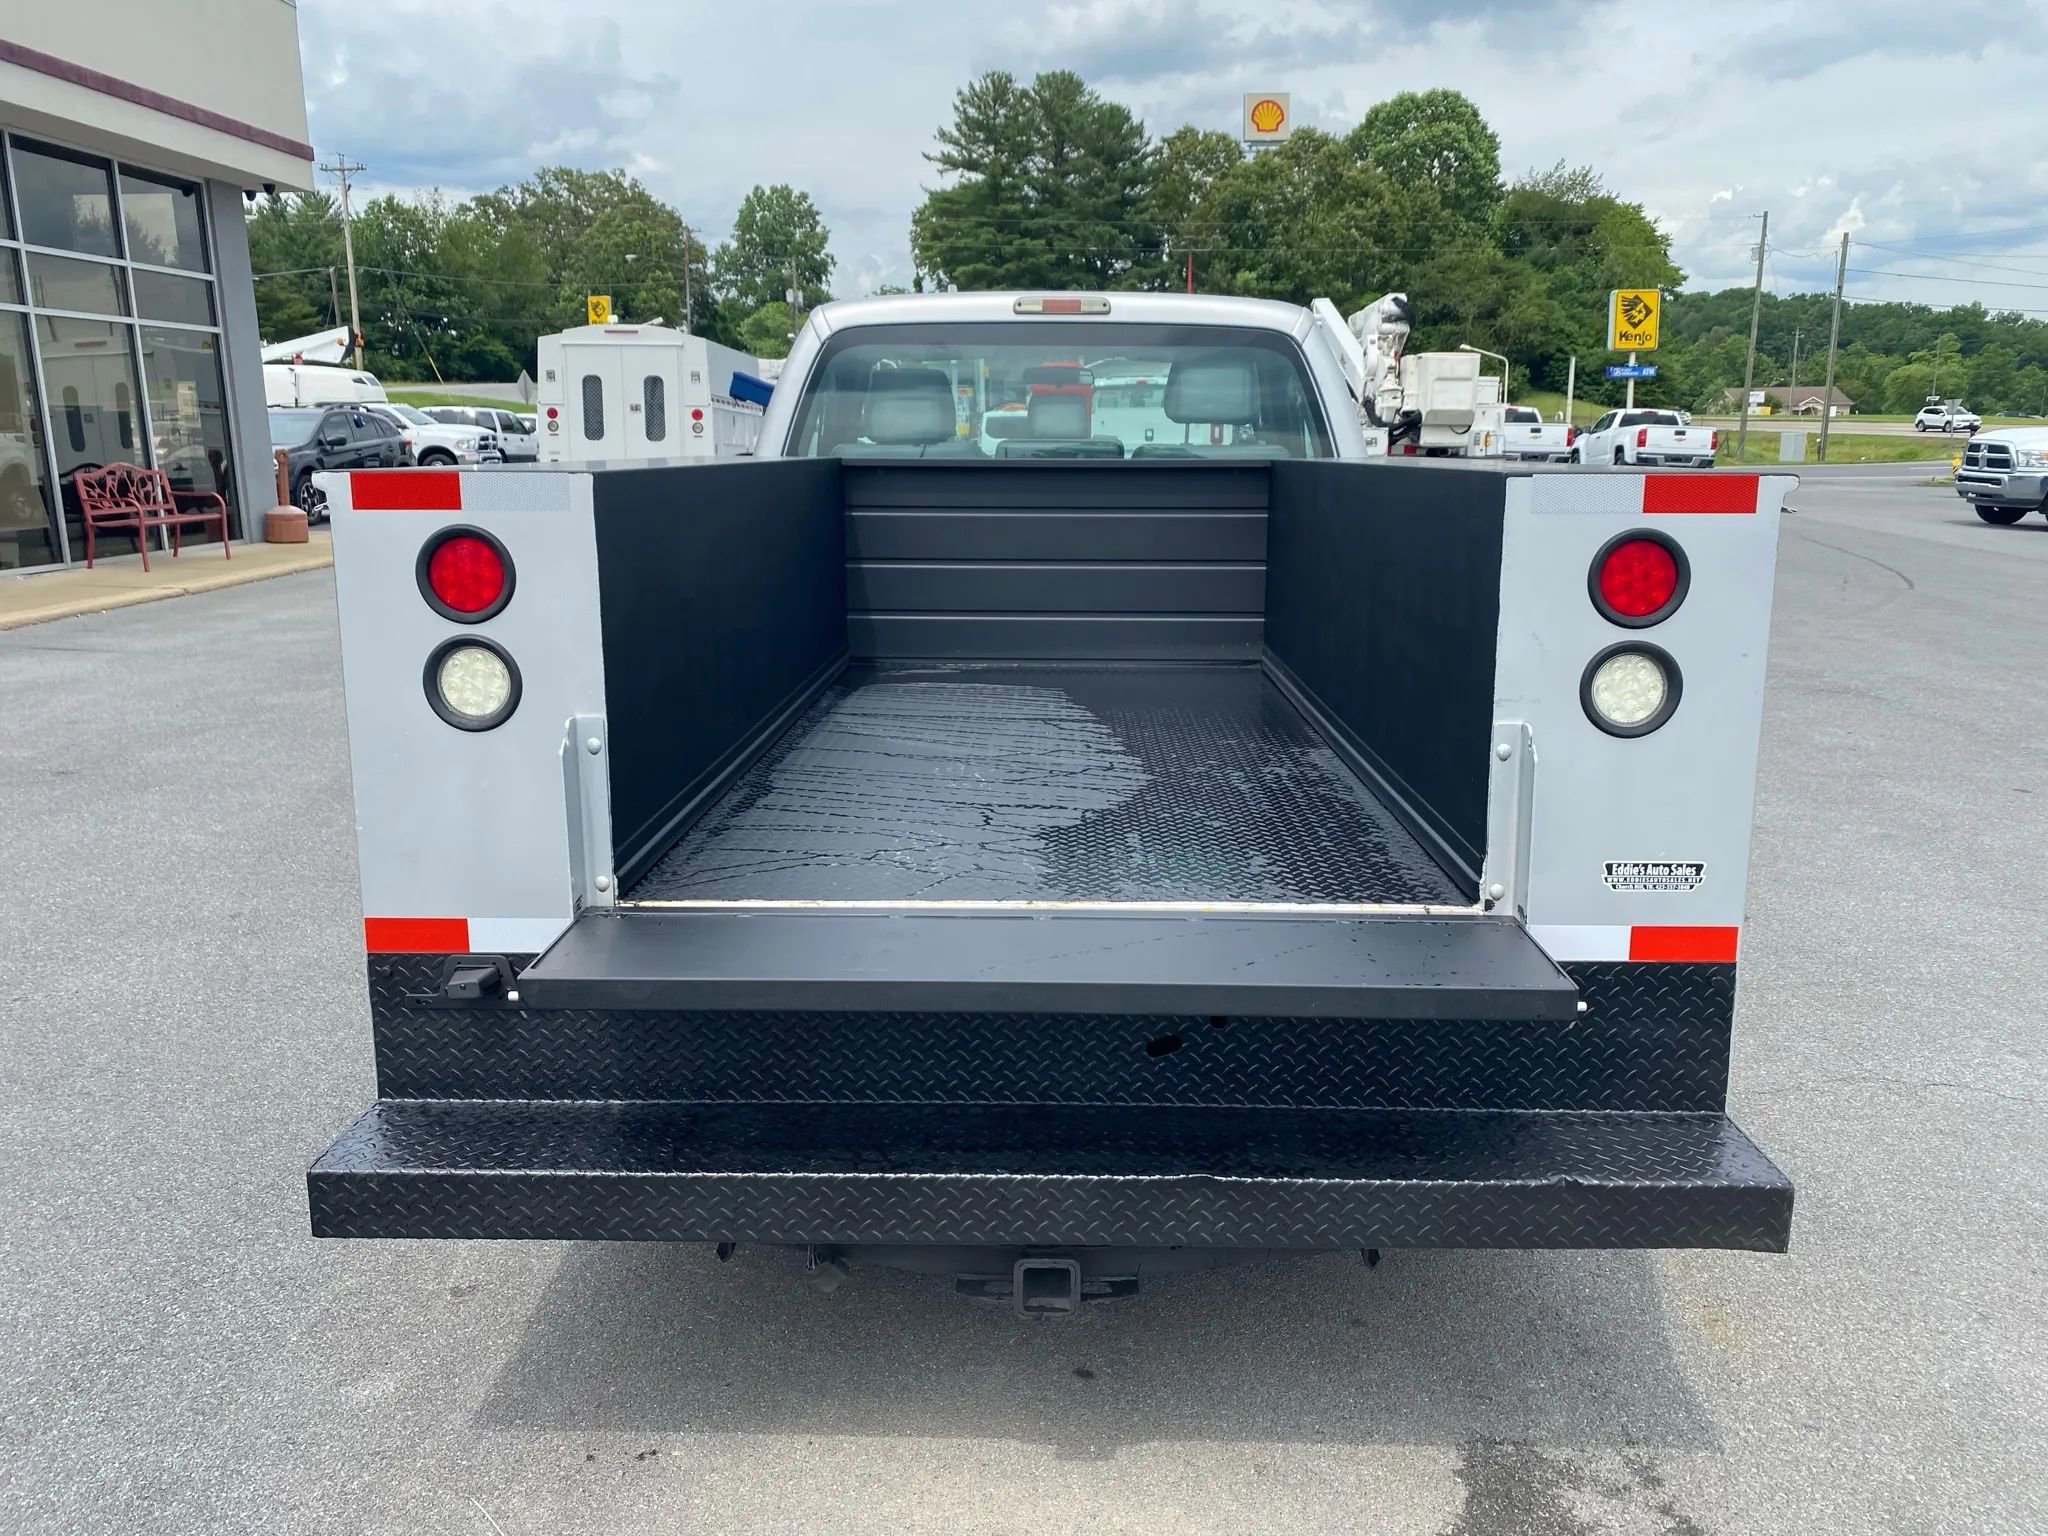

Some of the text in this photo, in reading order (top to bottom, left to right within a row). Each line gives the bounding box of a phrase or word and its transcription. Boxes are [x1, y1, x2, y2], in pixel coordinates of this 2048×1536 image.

[1642, 367, 1655, 376] ATM
[1612, 863, 1697, 876] Eddie's Auto Sales
